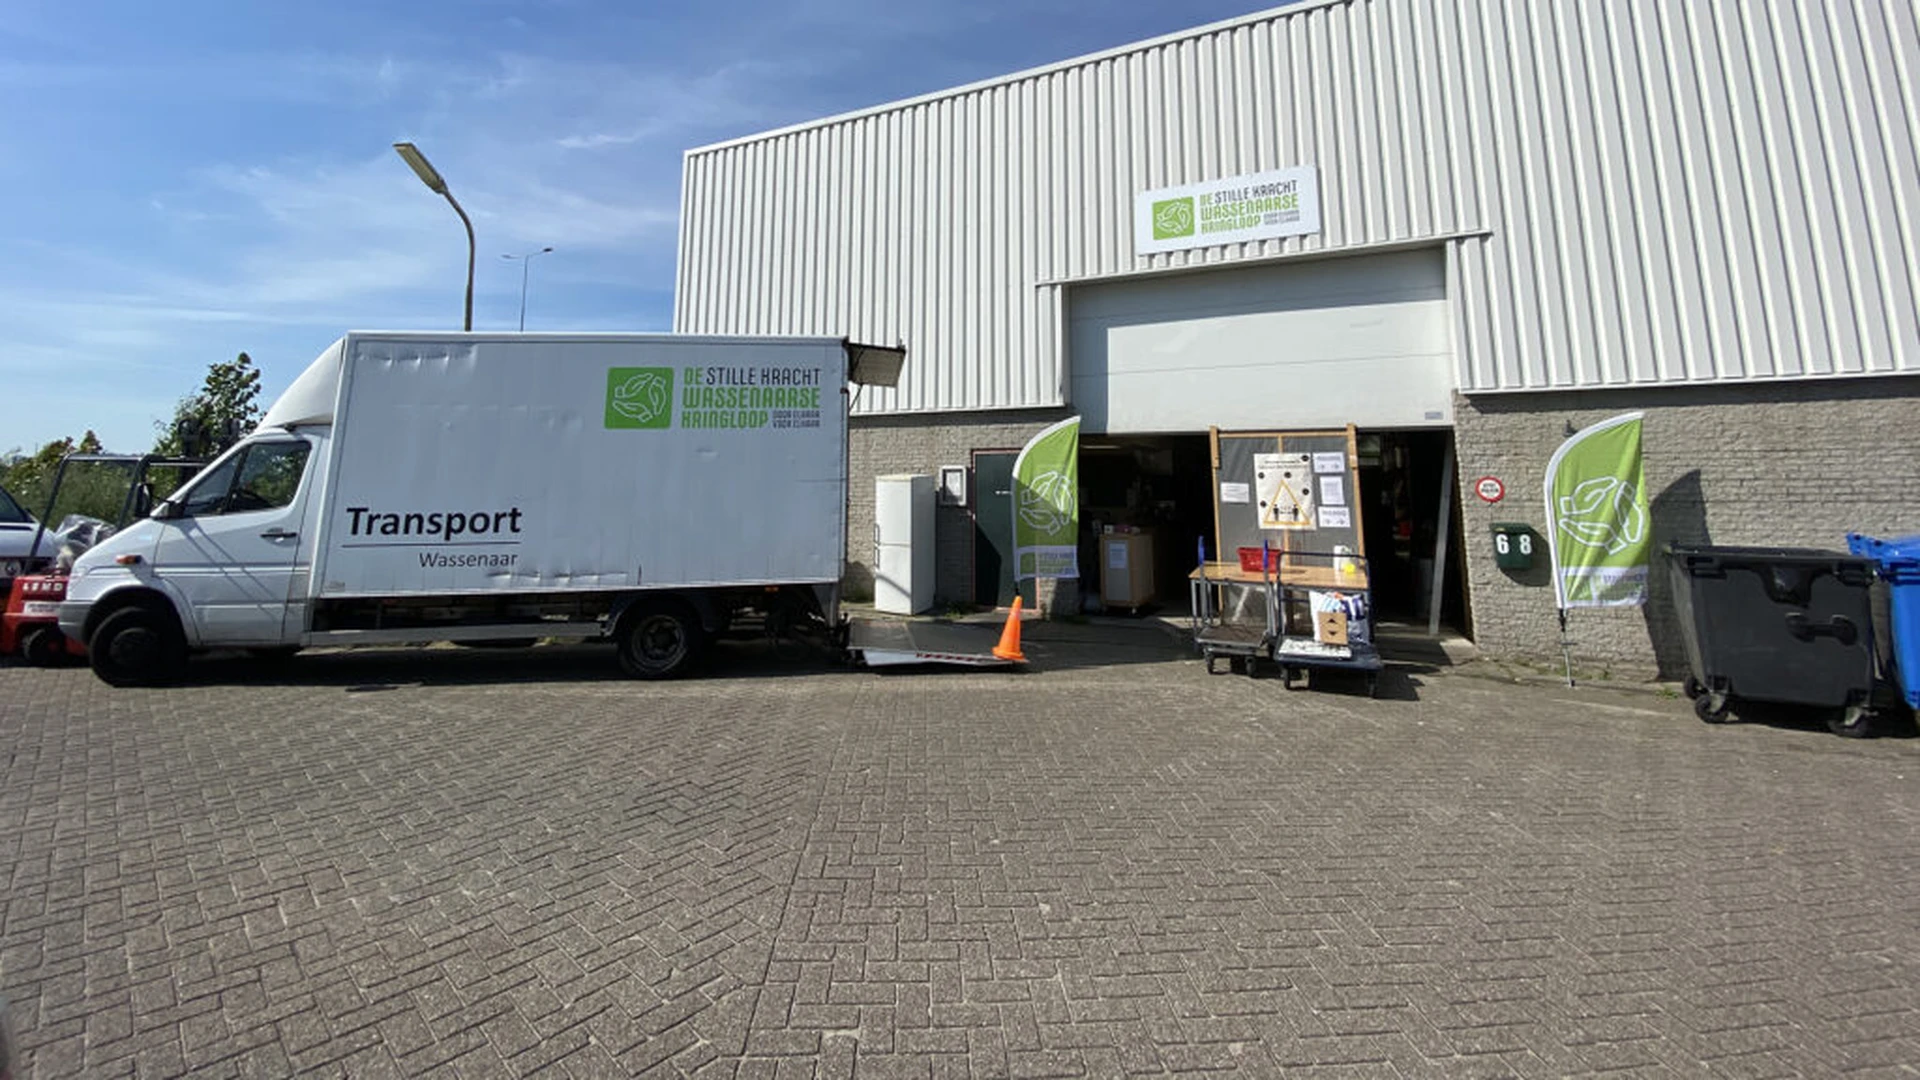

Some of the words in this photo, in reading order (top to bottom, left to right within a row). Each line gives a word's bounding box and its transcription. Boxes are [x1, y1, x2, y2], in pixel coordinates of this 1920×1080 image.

[1214, 187, 1250, 204] STILLE
[1252, 179, 1297, 198] KRACHT
[1200, 193, 1299, 221] WASSENAARSE
[683, 367, 704, 385] DE
[706, 366, 757, 386] STILLE
[760, 367, 821, 386] KRACHT
[682, 386, 820, 409] WASSENAARSE
[681, 410, 769, 428] KRINGLOOP
[346, 507, 523, 541] Transport
[418, 552, 518, 568] Wassenaar
